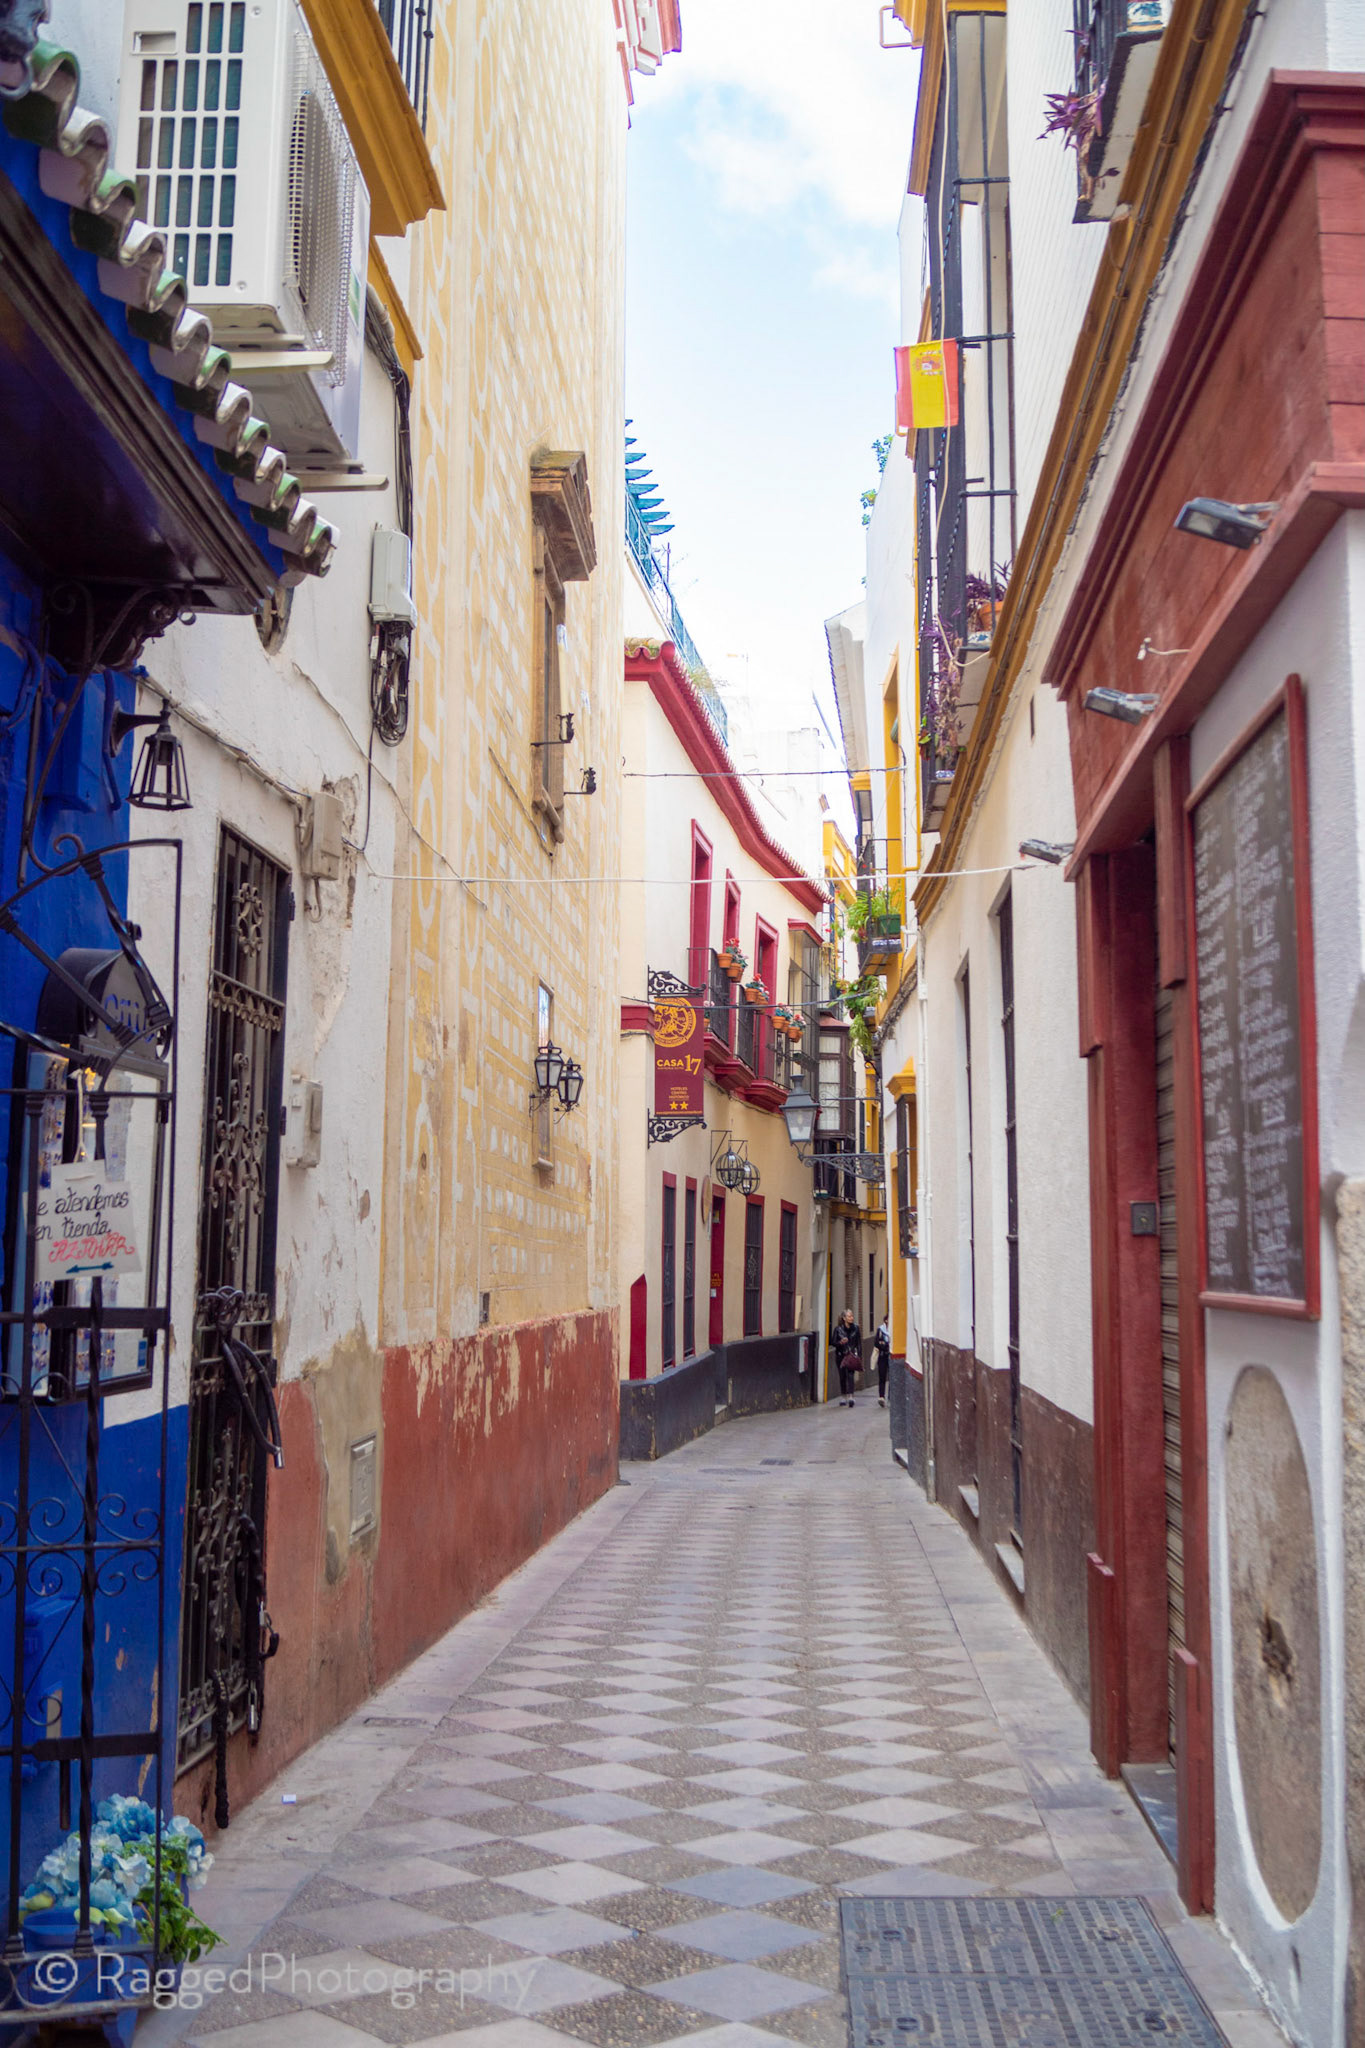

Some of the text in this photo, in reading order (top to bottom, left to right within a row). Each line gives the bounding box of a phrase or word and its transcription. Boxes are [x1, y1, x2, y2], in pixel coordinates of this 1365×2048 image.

[685, 1054, 702, 1076] 17
[55, 1184, 129, 1214] atendemos
[34, 1225, 53, 1241] en
